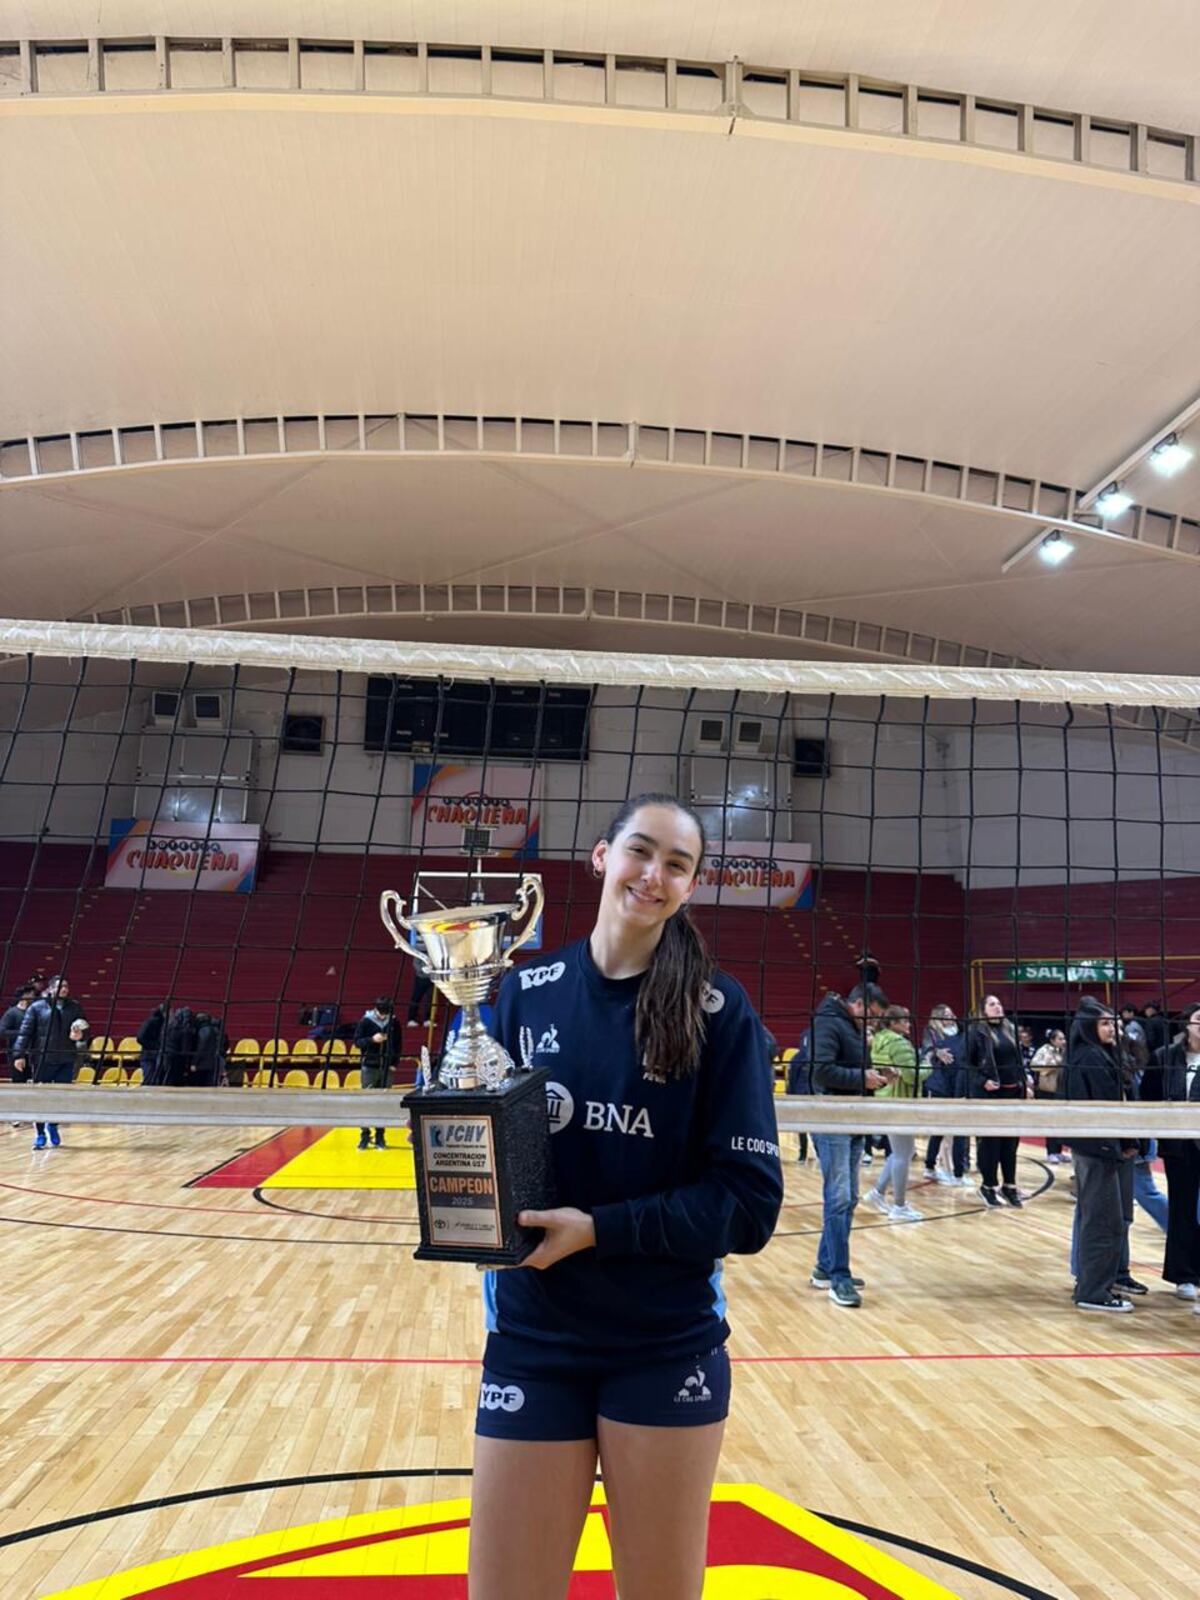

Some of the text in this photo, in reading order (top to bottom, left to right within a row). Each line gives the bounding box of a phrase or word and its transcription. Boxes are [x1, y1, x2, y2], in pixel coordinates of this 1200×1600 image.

[1025, 966, 1099, 979] SALDA
[583, 1101, 655, 1138] BNA
[446, 1125, 486, 1142] FCHV
[731, 1136, 745, 1151] LE
[747, 1138, 766, 1154] COQ
[433, 1151, 487, 1160] CONCENTRACION
[435, 1160, 471, 1168] ARGENTINA
[429, 1176, 493, 1195] CAMPEON
[451, 1196, 473, 1206] 2025
